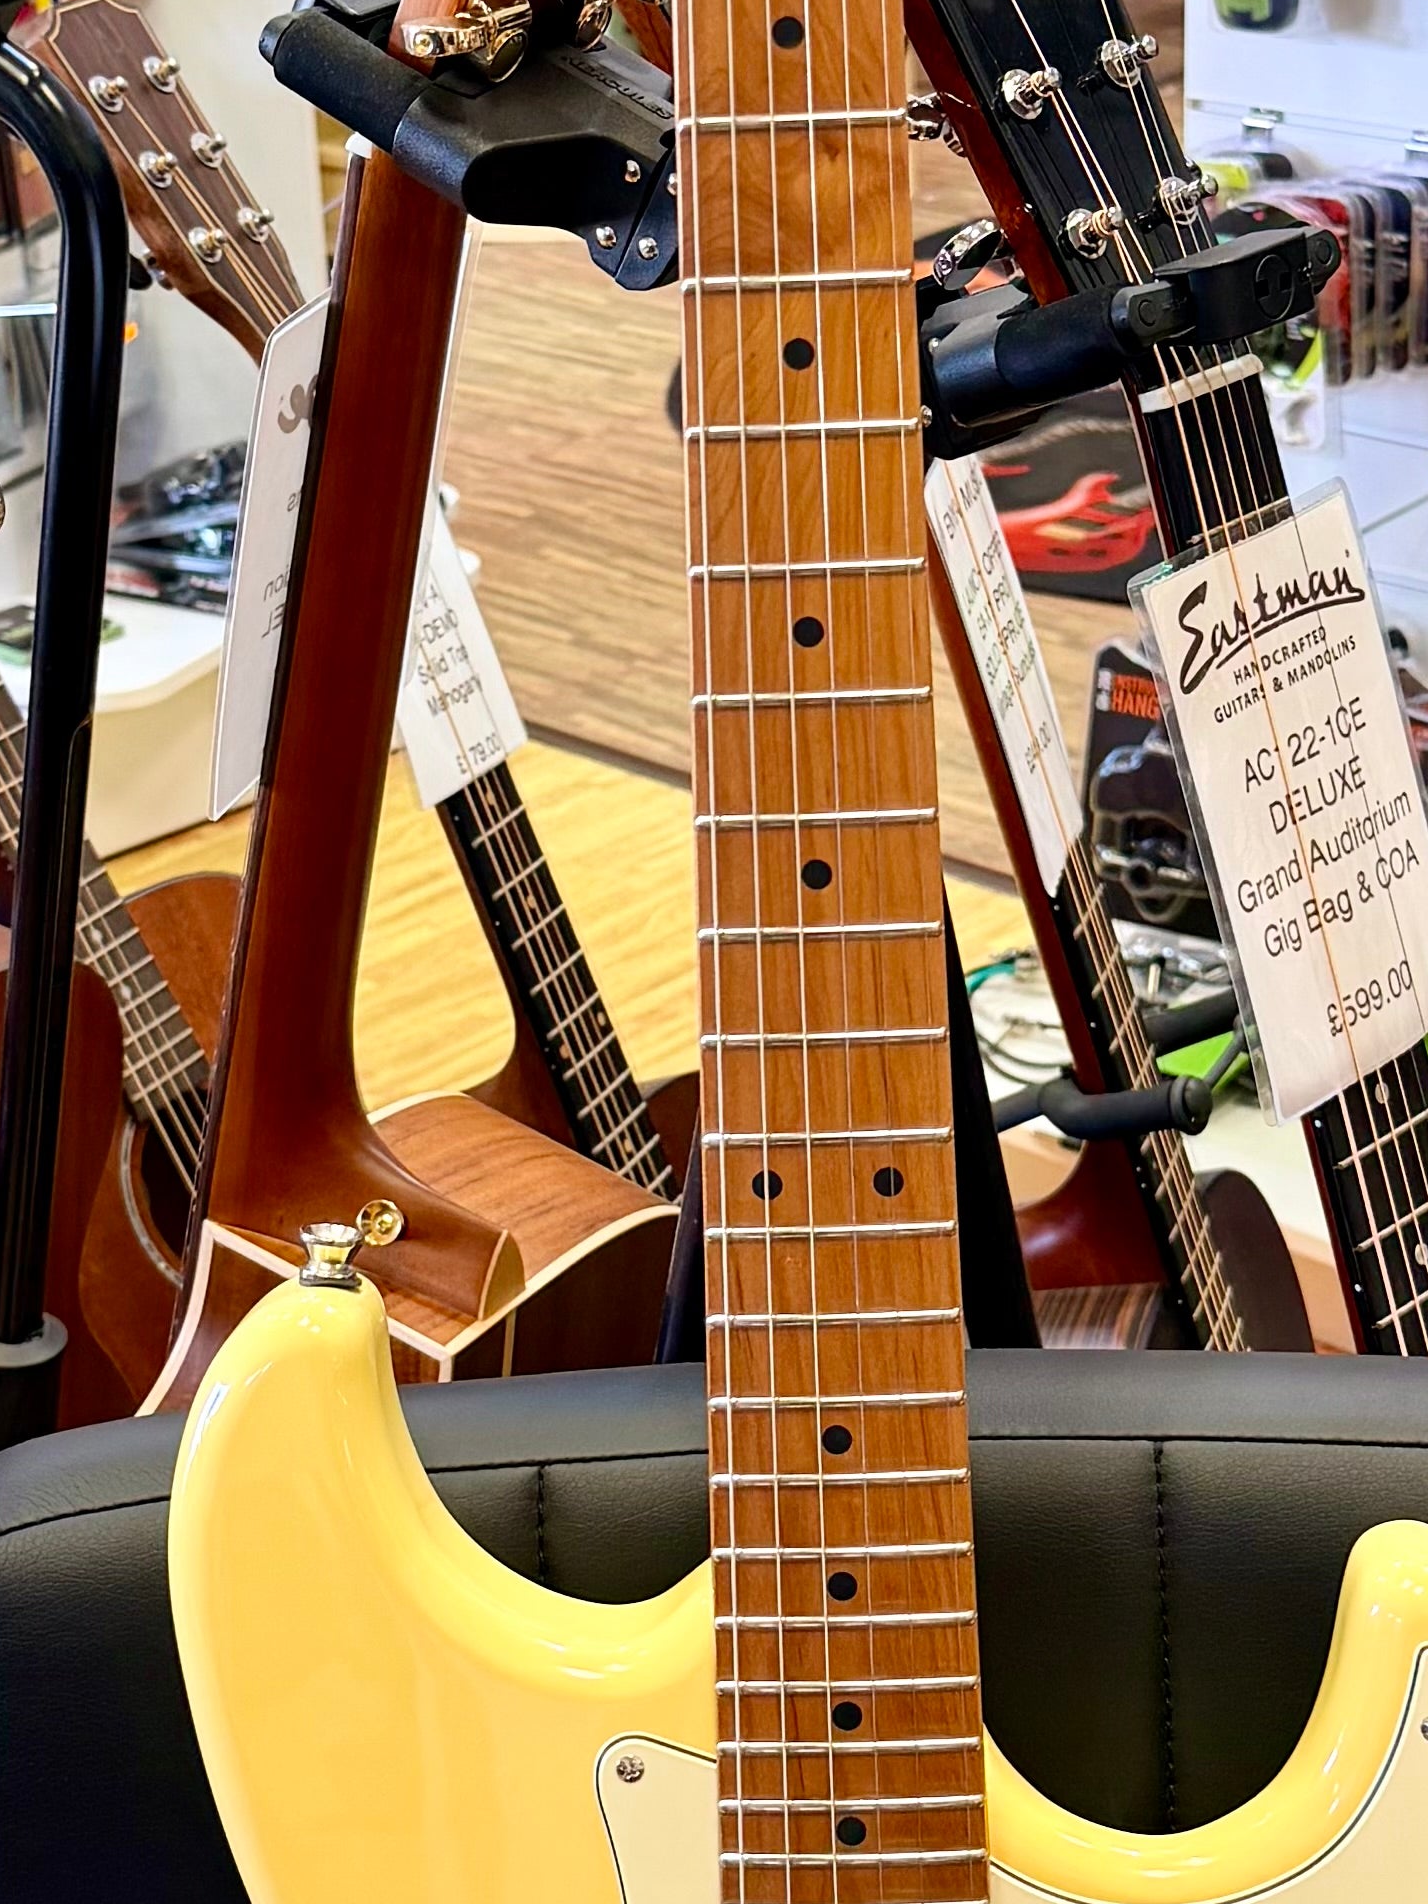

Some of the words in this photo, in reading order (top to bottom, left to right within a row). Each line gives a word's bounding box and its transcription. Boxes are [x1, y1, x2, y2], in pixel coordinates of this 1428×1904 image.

[1177, 563, 1367, 698] Eastman
[1232, 625, 1330, 687] HANDCRAFTED
[1111, 688, 1161, 721] HANG
[1212, 679, 1269, 726] GUITARS
[1271, 677, 1286, 695] &
[1285, 634, 1359, 687] MANDOLINS
[455, 732, 503, 776] £79.00
[1242, 696, 1368, 794] AC22-1CE
[1267, 753, 1368, 837] DELUXE
[1236, 850, 1306, 917] Grand
[1307, 787, 1414, 876] Auditorium
[1262, 910, 1306, 962] Gig
[1303, 885, 1356, 938] Bag
[1356, 871, 1377, 907] &
[1374, 846, 1422, 895] COA
